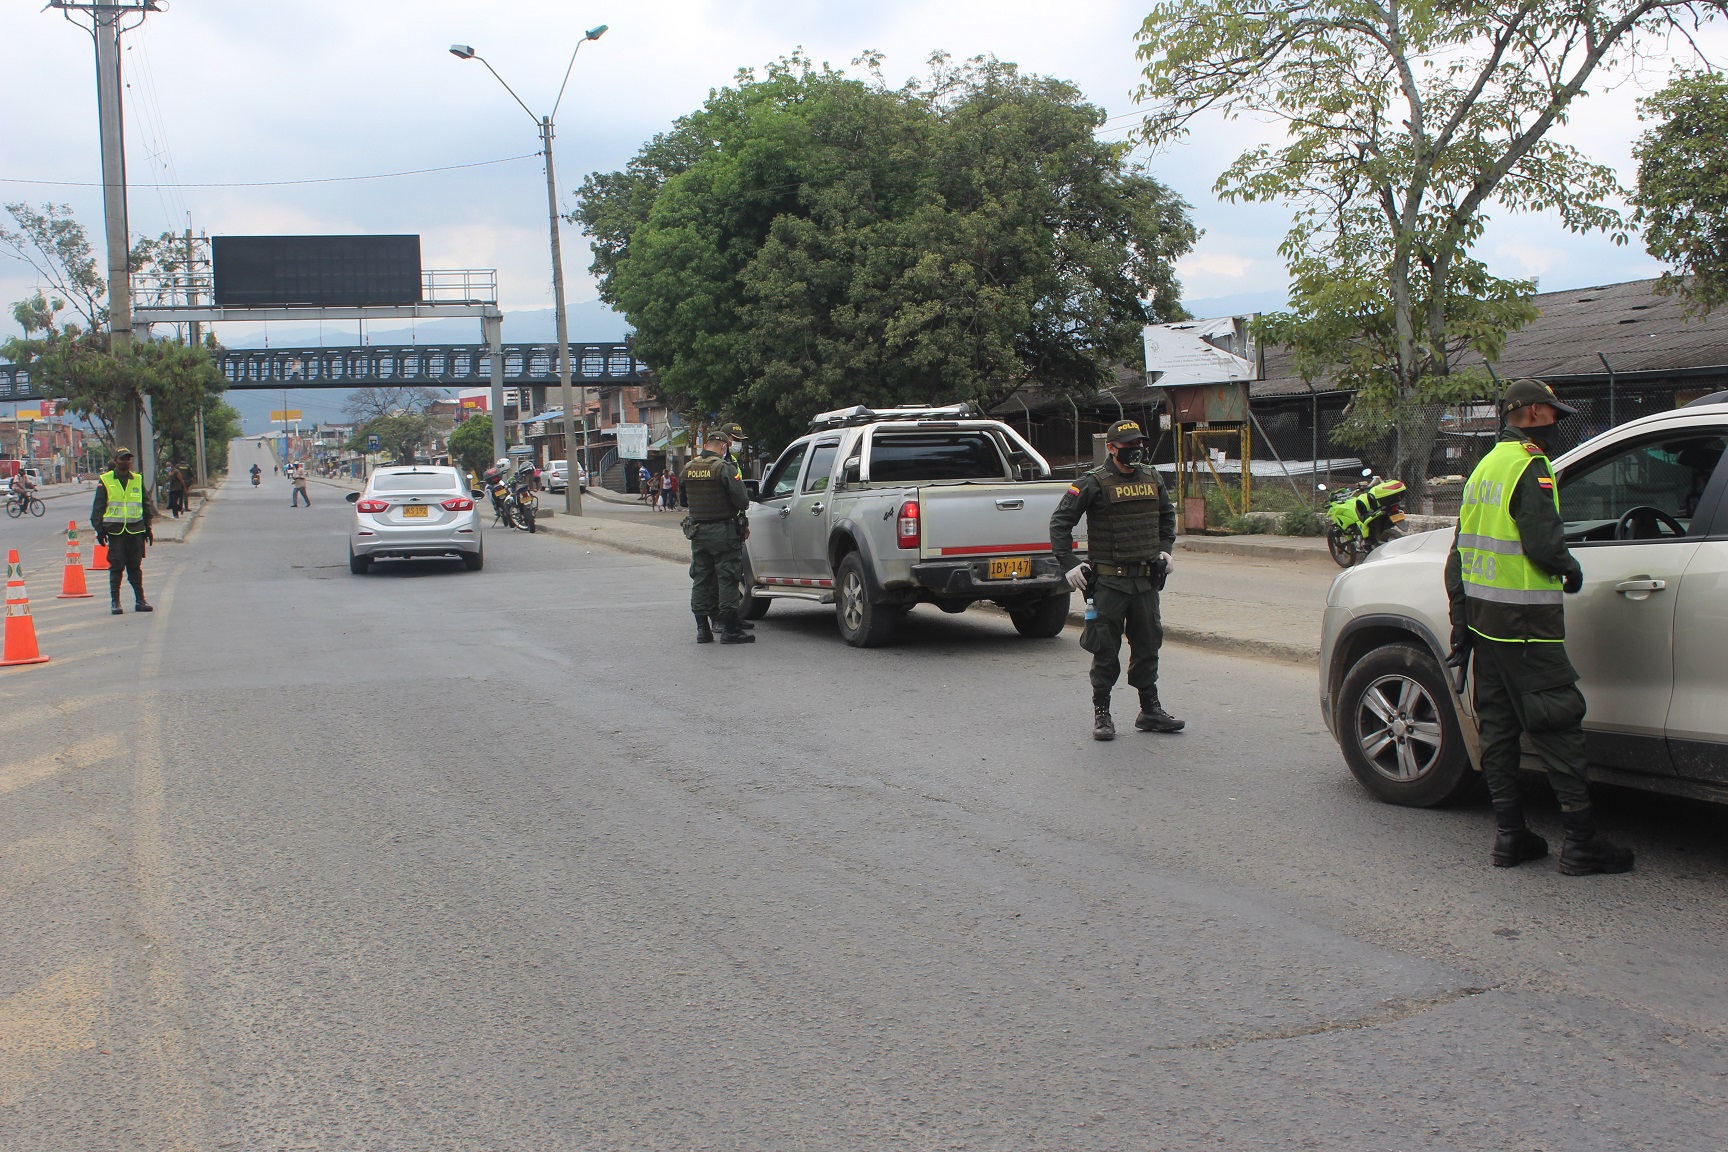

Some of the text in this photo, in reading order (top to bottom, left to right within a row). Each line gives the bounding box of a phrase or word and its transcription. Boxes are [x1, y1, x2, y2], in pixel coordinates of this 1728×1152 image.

[687, 470, 711, 478] POLICIA
[1115, 484, 1154, 498] POLICIA
[1462, 551, 1496, 580] 548
